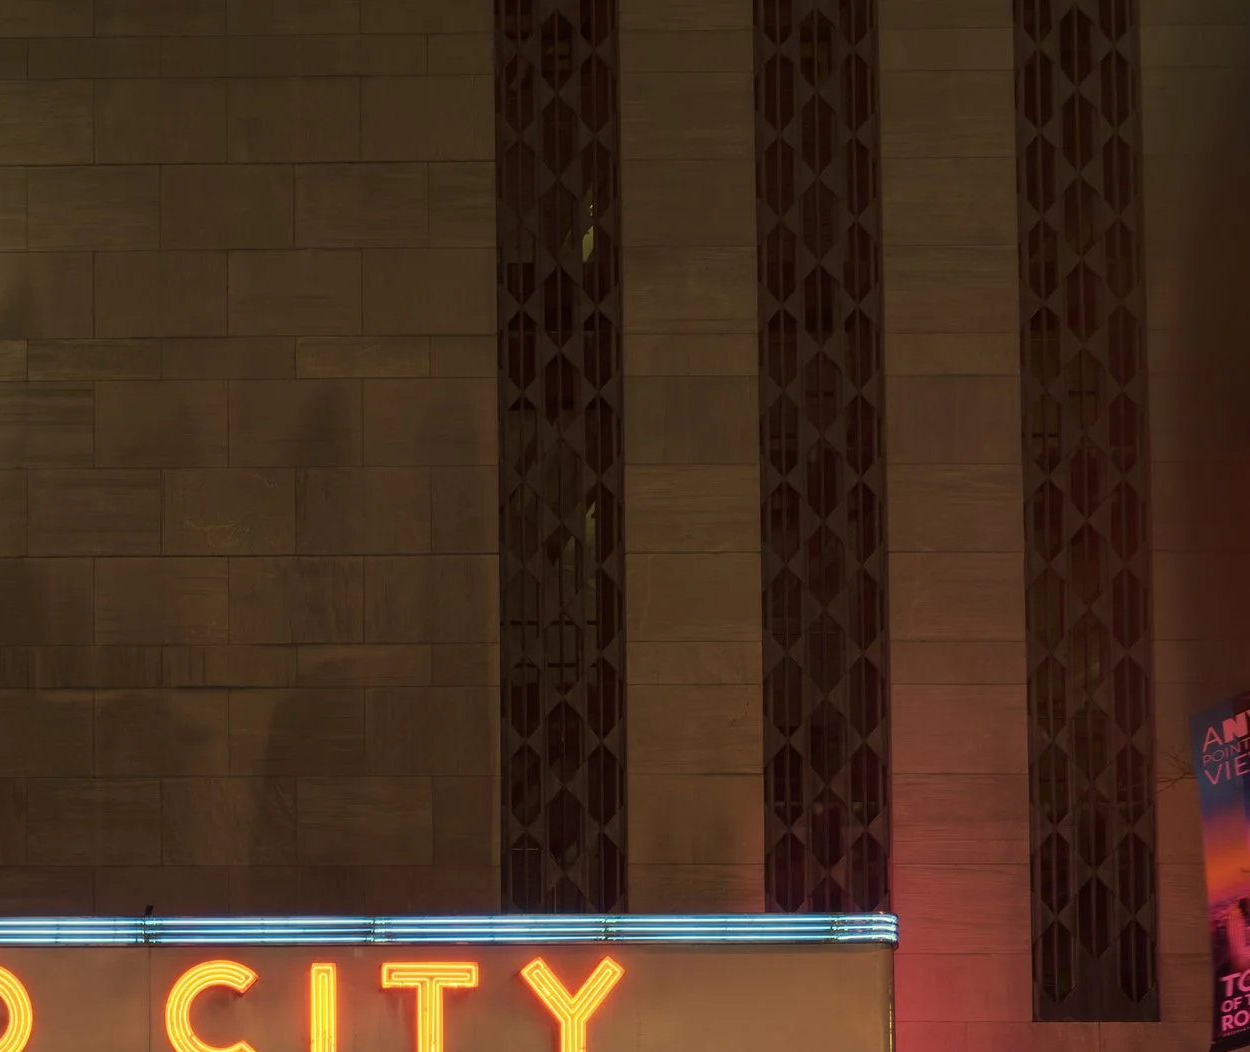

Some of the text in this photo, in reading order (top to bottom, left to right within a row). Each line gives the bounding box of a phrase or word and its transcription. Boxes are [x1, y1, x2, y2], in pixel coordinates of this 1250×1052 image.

[1203, 709, 1250, 753] AN
[1204, 752, 1250, 785] VIE
[1221, 996, 1243, 1013] OF
[1222, 1009, 1250, 1031] RO
